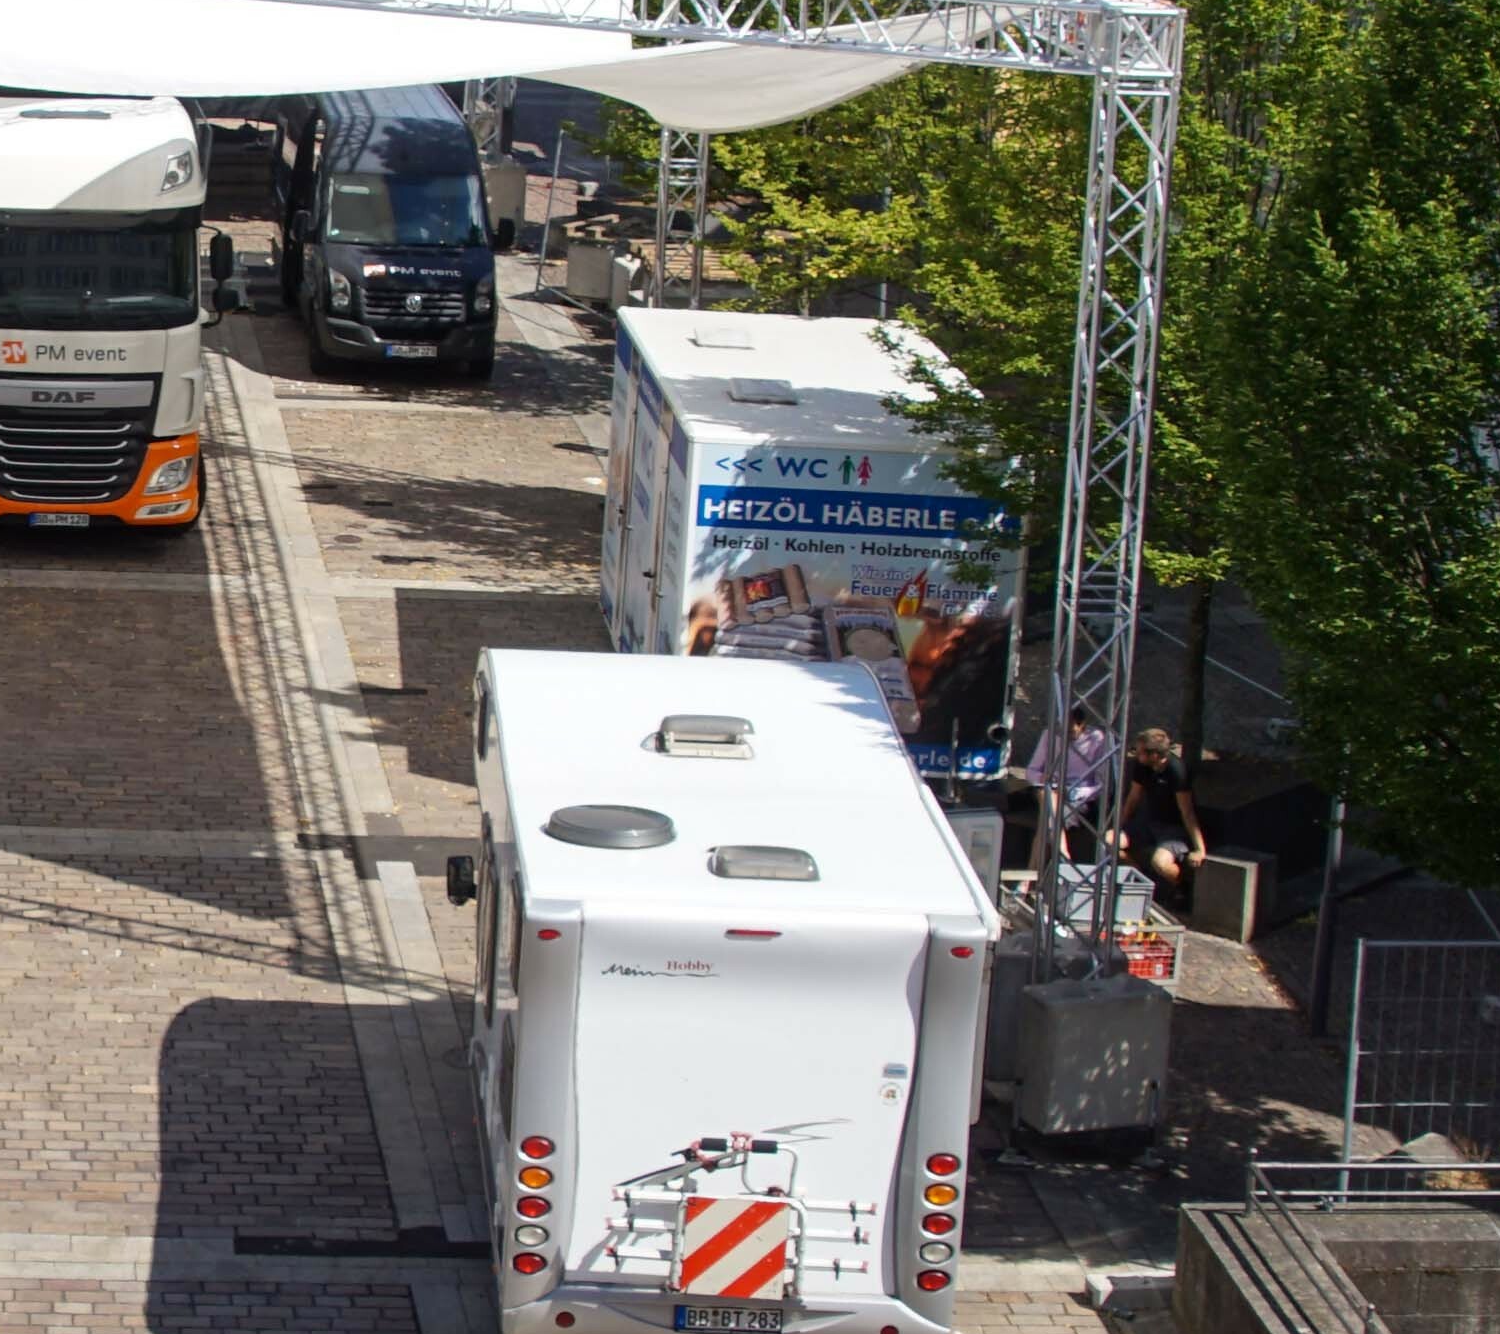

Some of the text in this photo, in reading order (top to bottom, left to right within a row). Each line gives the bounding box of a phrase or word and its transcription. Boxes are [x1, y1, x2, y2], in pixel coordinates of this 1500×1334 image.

[36, 345, 127, 361] PM event
[31, 391, 96, 403] DAF
[776, 457, 828, 478] WC
[704, 496, 814, 524] HEIZÖL
[822, 501, 957, 531] HÄBERLE
[712, 535, 770, 550] Heizöl
[784, 540, 846, 555] Kohlen
[851, 580, 902, 597] Feuer
[926, 584, 1001, 603] Flamme
[666, 960, 714, 974] Hobby
[687, 1310, 778, 1329] BB BT 283
